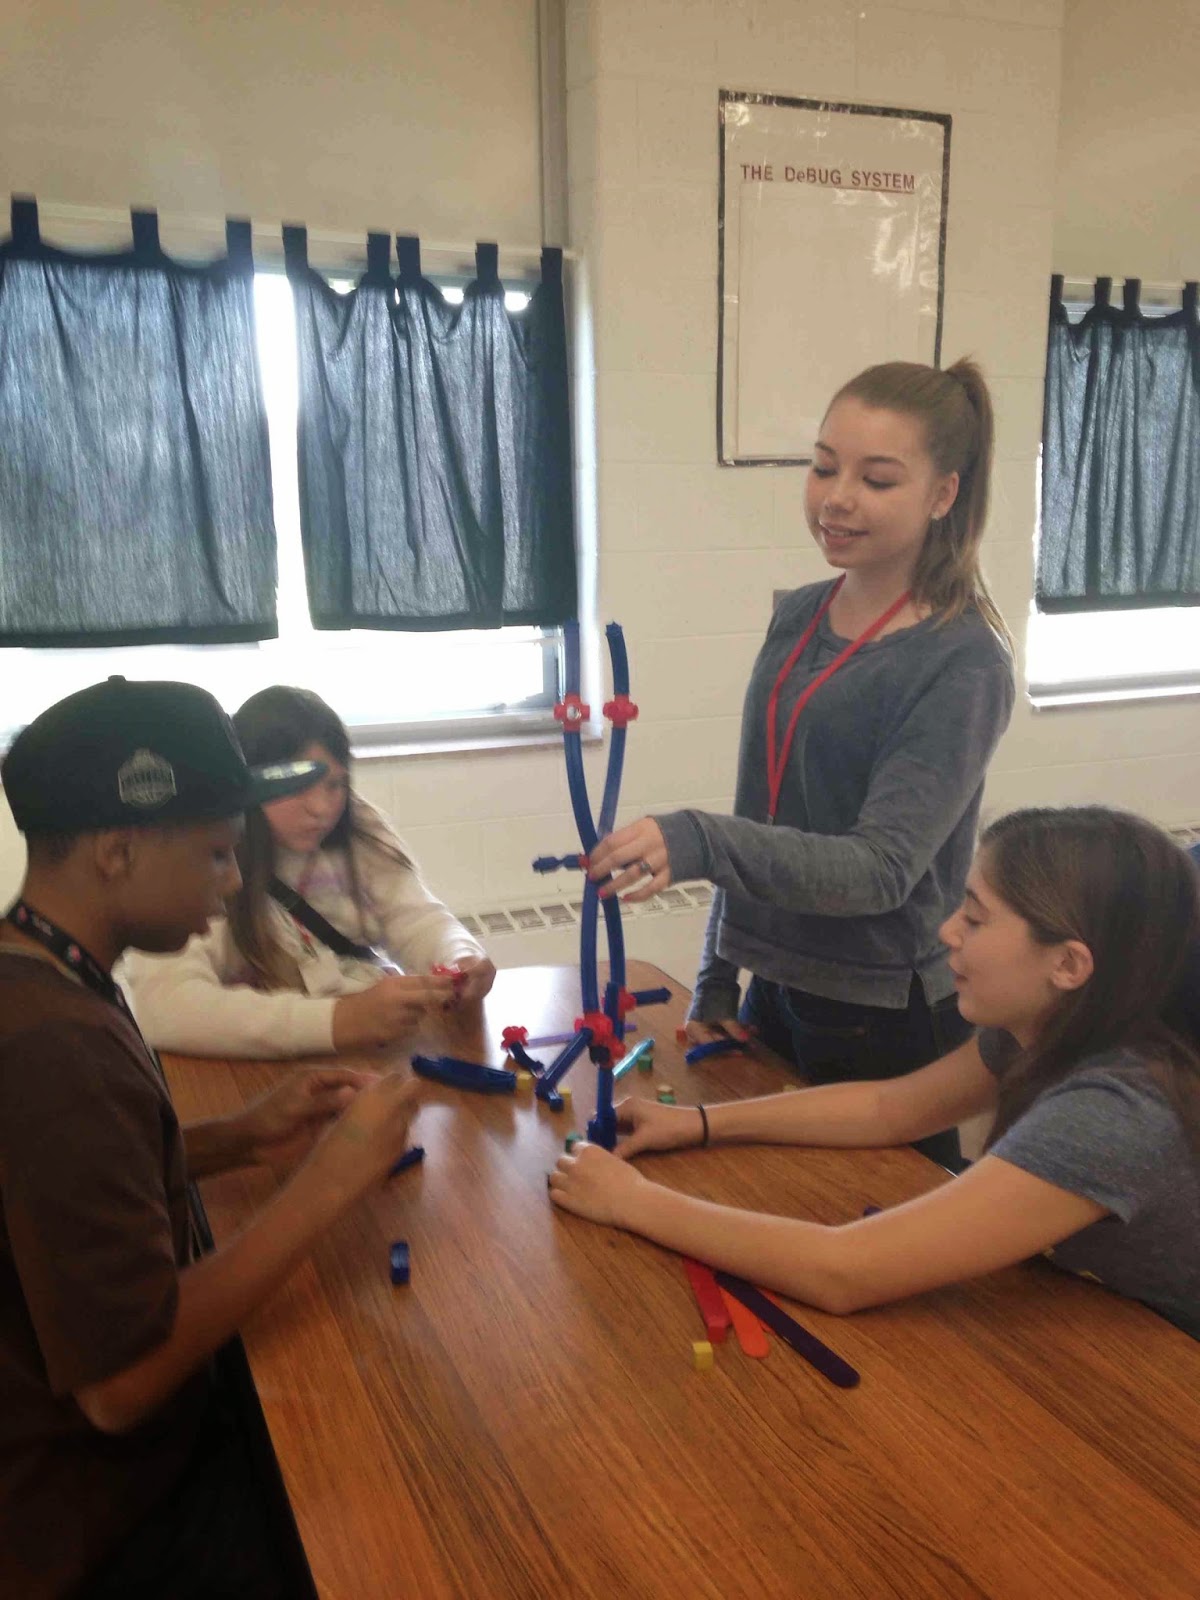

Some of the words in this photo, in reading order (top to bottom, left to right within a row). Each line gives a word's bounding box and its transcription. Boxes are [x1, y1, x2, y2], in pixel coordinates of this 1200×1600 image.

[740, 164, 773, 182] THE
[784, 166, 842, 185] DeBUG
[851, 170, 915, 190] SYSTEM
